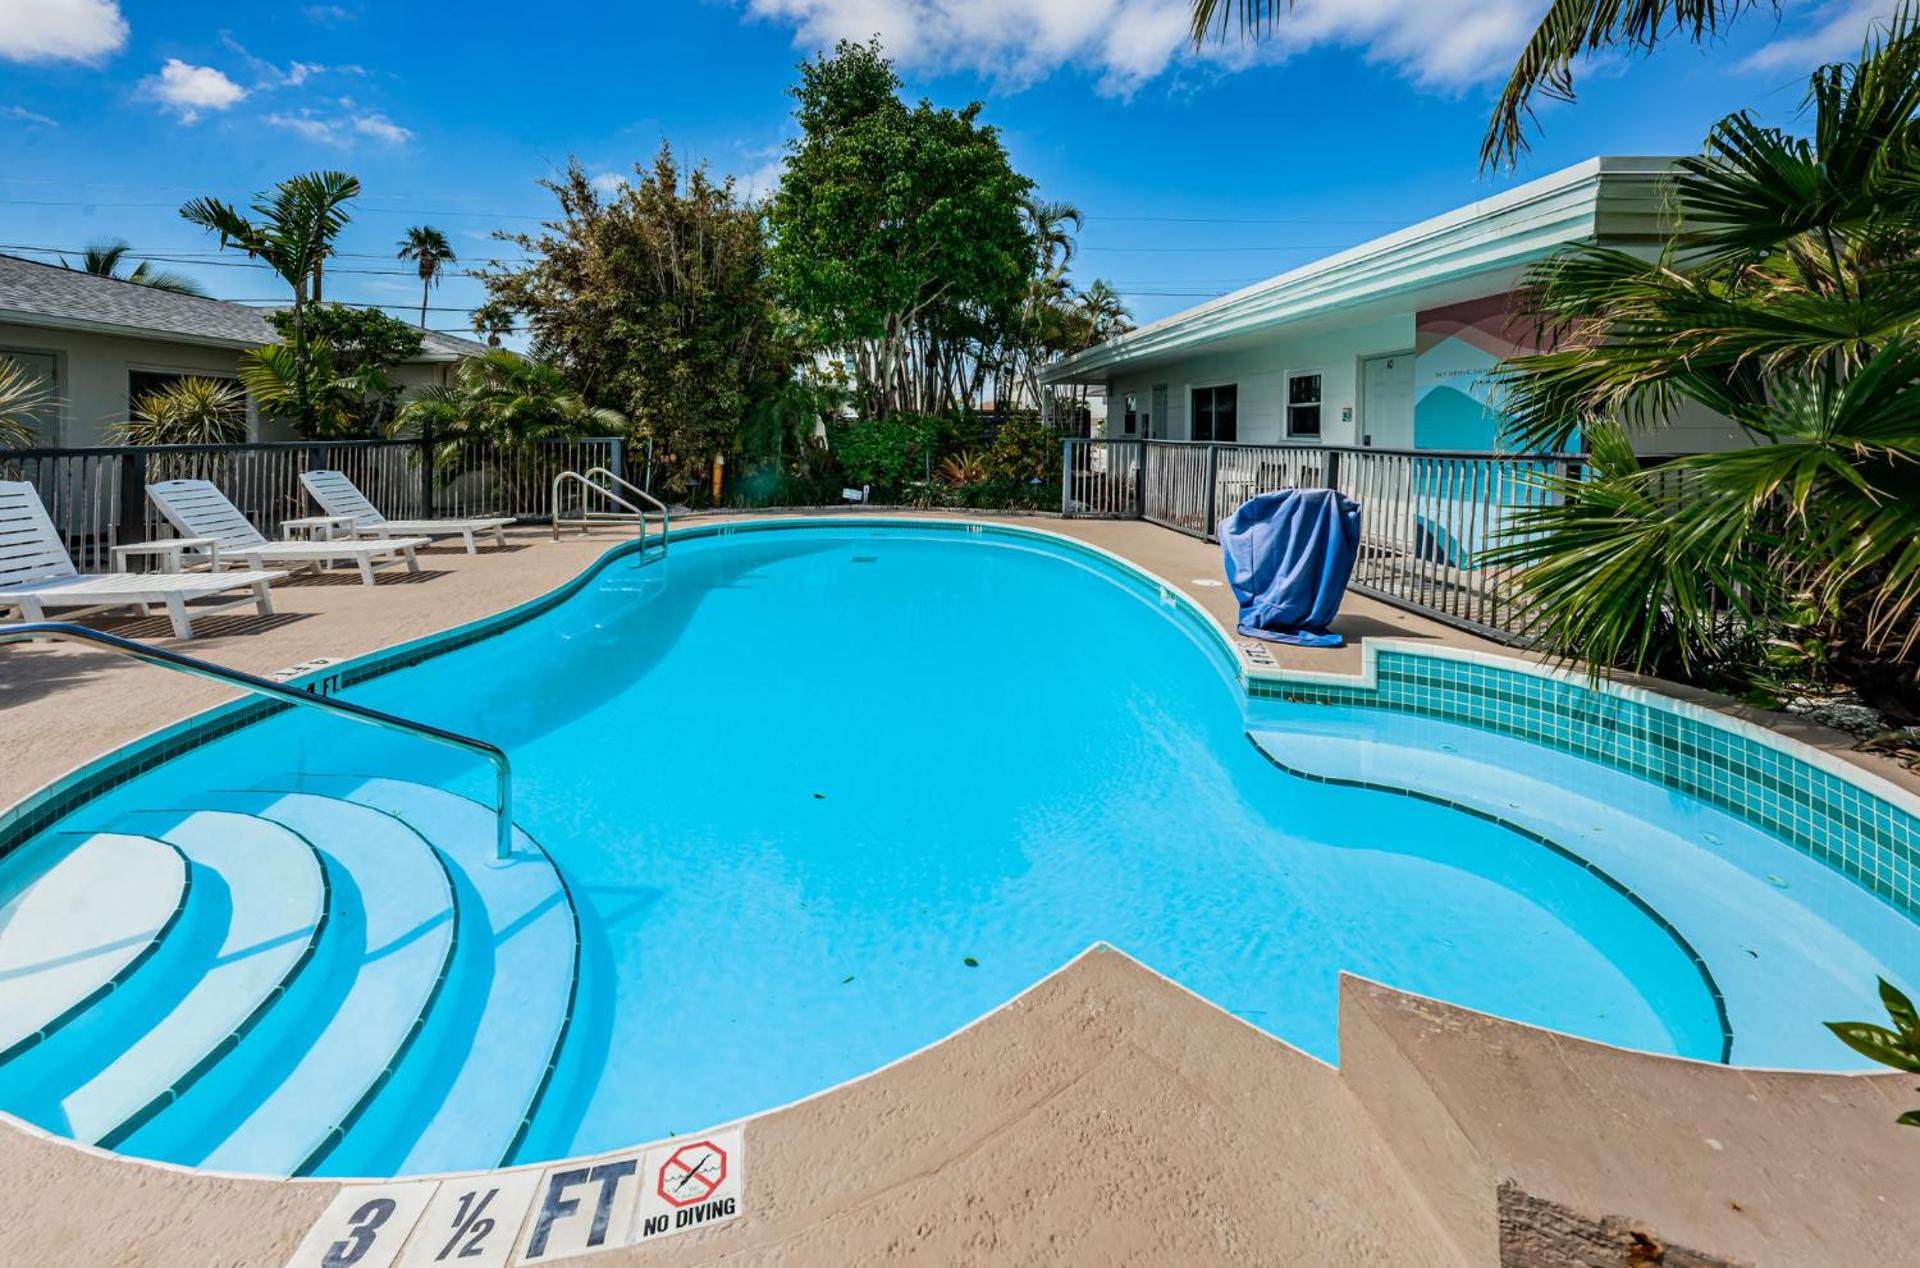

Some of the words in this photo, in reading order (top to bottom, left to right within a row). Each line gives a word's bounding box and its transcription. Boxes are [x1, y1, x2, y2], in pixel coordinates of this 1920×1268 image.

[323, 674, 339, 697] FT
[321, 1198, 397, 1268] 3
[525, 1159, 638, 1259] FT
[643, 1214, 669, 1237] NO
[676, 1197, 736, 1229] DIVING
